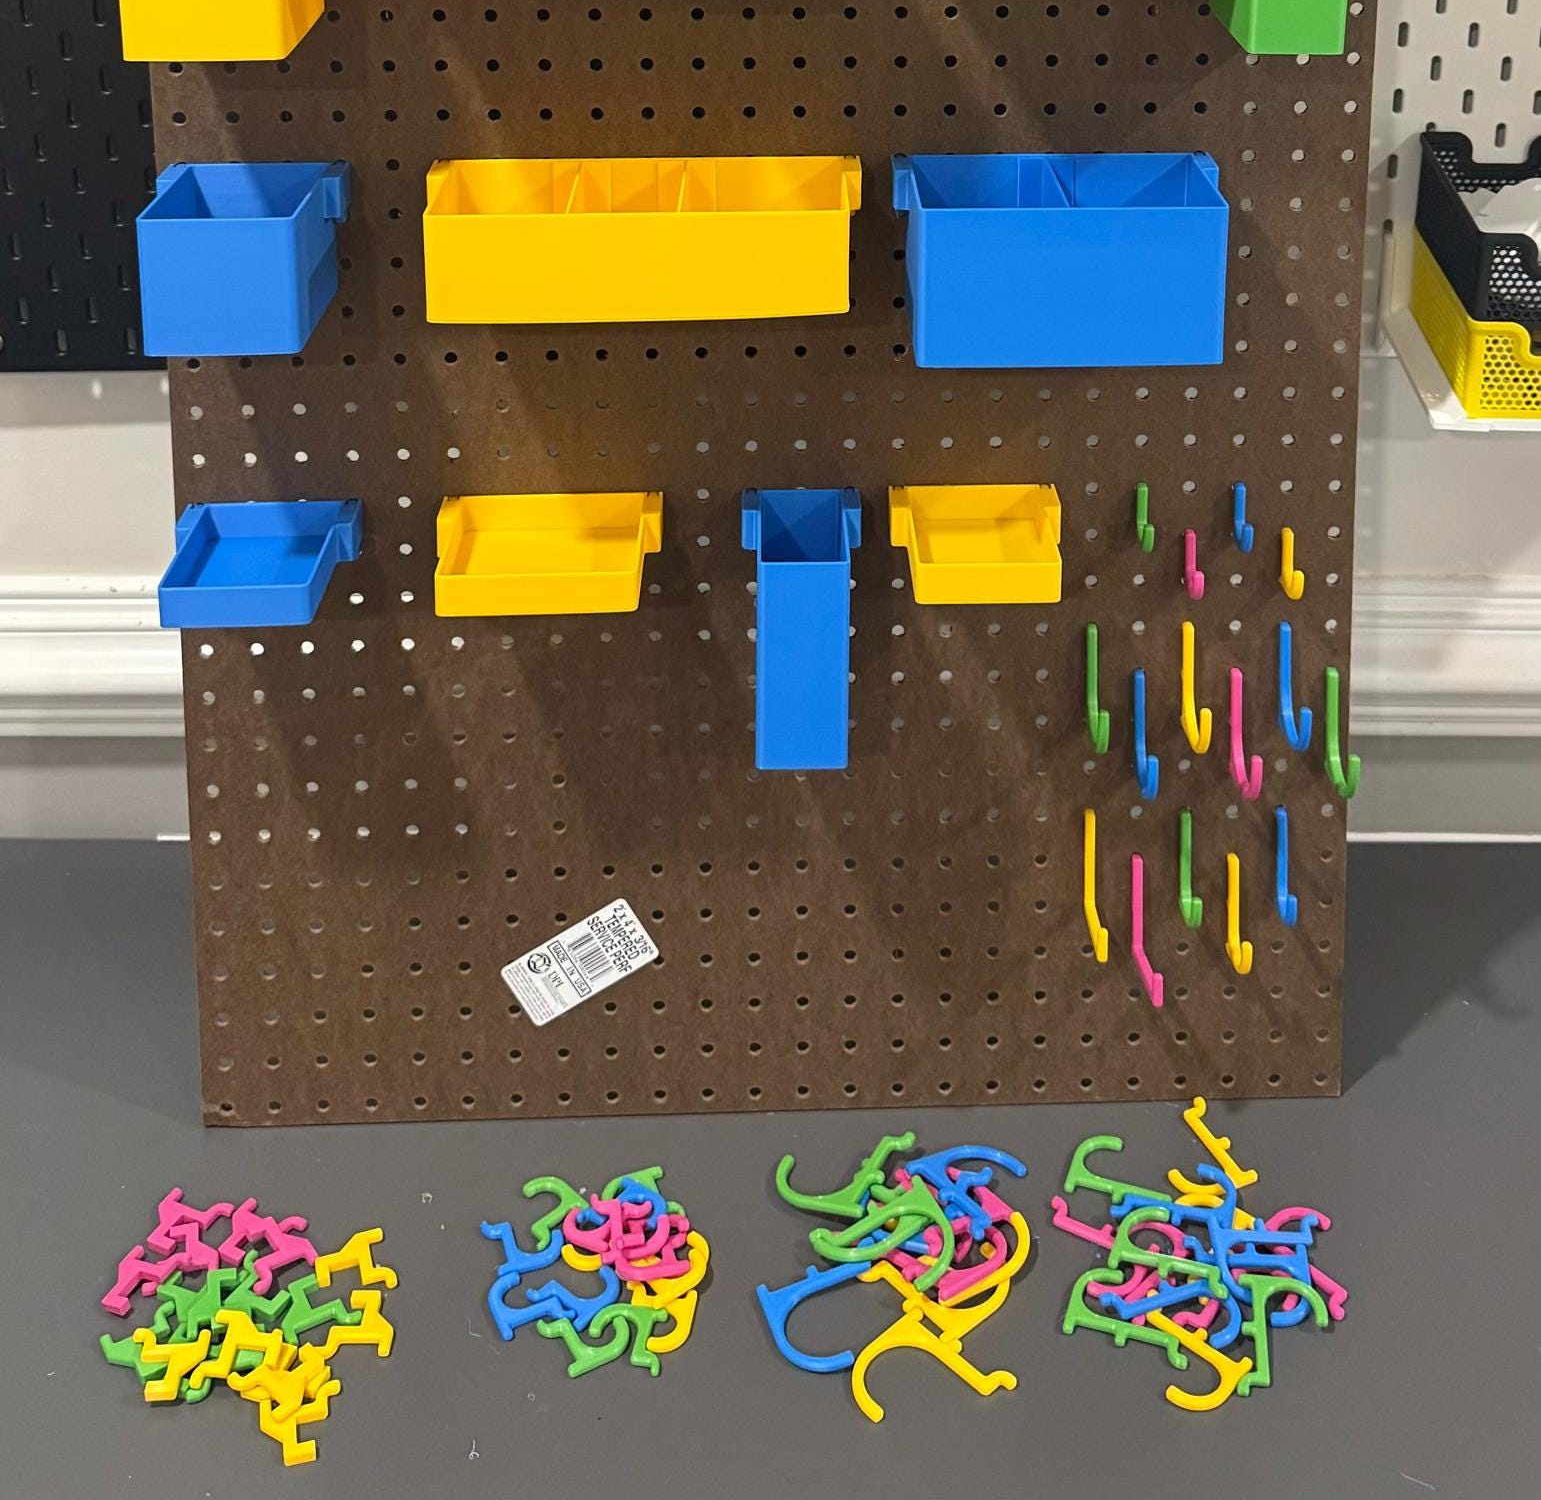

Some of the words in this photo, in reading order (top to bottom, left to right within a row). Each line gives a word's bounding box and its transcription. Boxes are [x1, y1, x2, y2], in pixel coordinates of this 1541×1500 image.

[587, 916, 618, 953] SERVICE
[612, 952, 632, 973] PERF
[604, 914, 640, 961] TEMPERED
[552, 944, 568, 964] MADE
[566, 966, 575, 976] IN
[574, 978, 588, 994] USA
